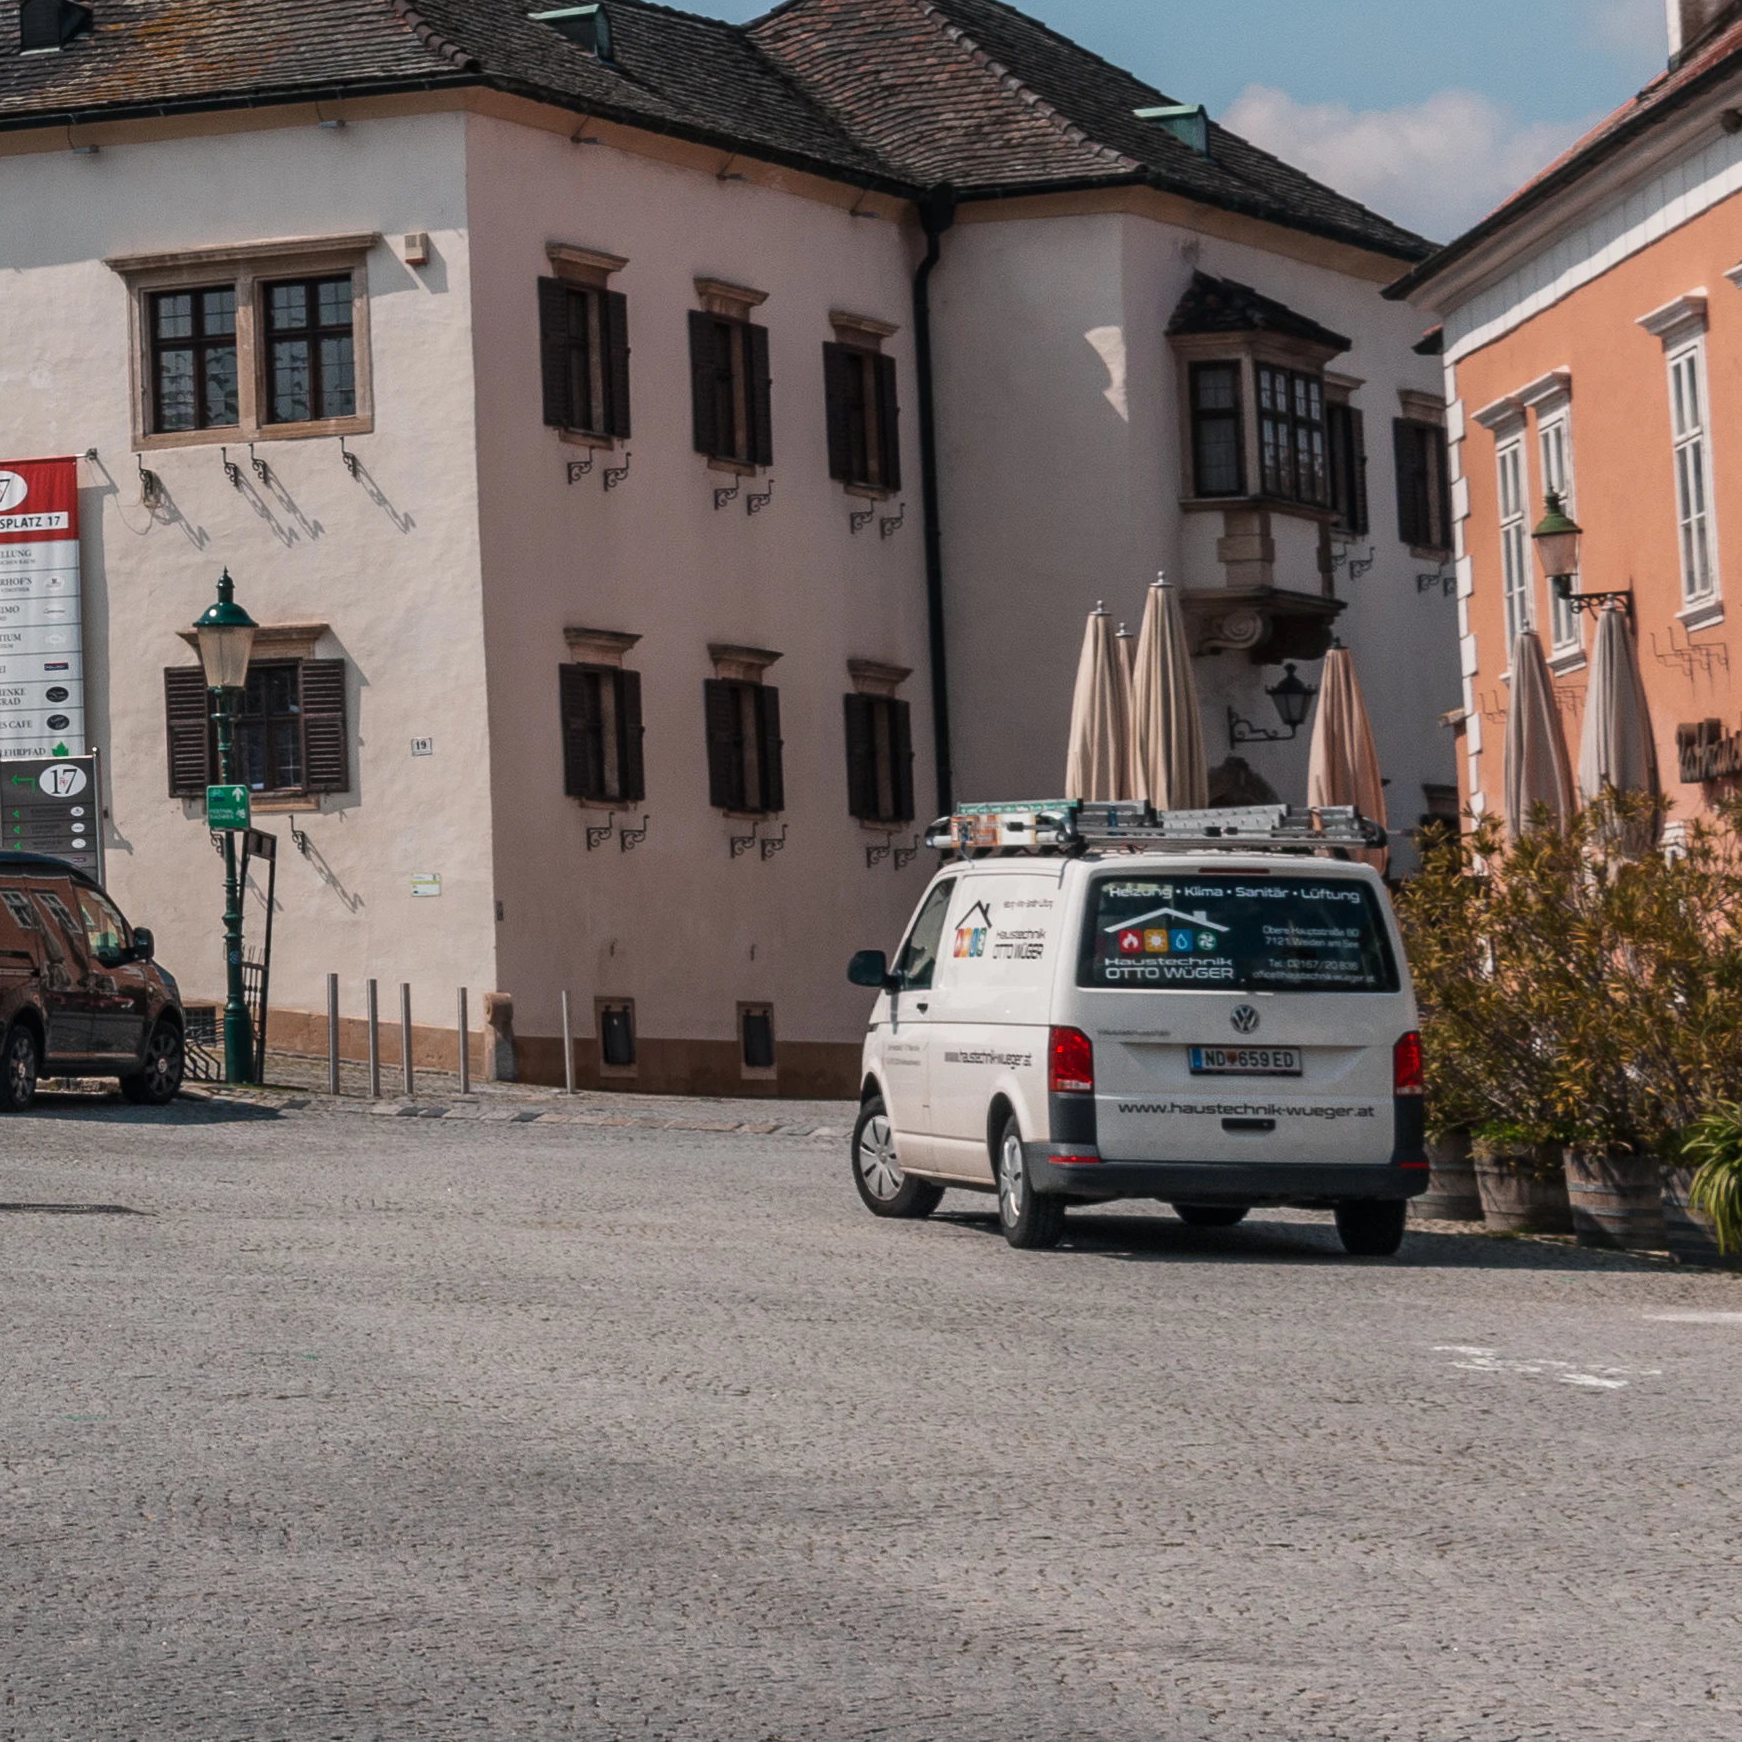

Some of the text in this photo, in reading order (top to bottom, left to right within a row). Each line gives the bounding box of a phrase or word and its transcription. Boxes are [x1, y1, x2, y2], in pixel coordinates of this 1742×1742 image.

[47, 515, 61, 527] 17
[50, 768, 78, 795] 17
[1108, 886, 1361, 903] Heizung Klima Sanitär Lüftung
[1104, 957, 1233, 966] Haustechnik
[1105, 966, 1234, 980] OTTO WÜGER
[1204, 1049, 1294, 1069] ND 659 ED
[1118, 1102, 1375, 1119] www.haustechnik-wueger.at
